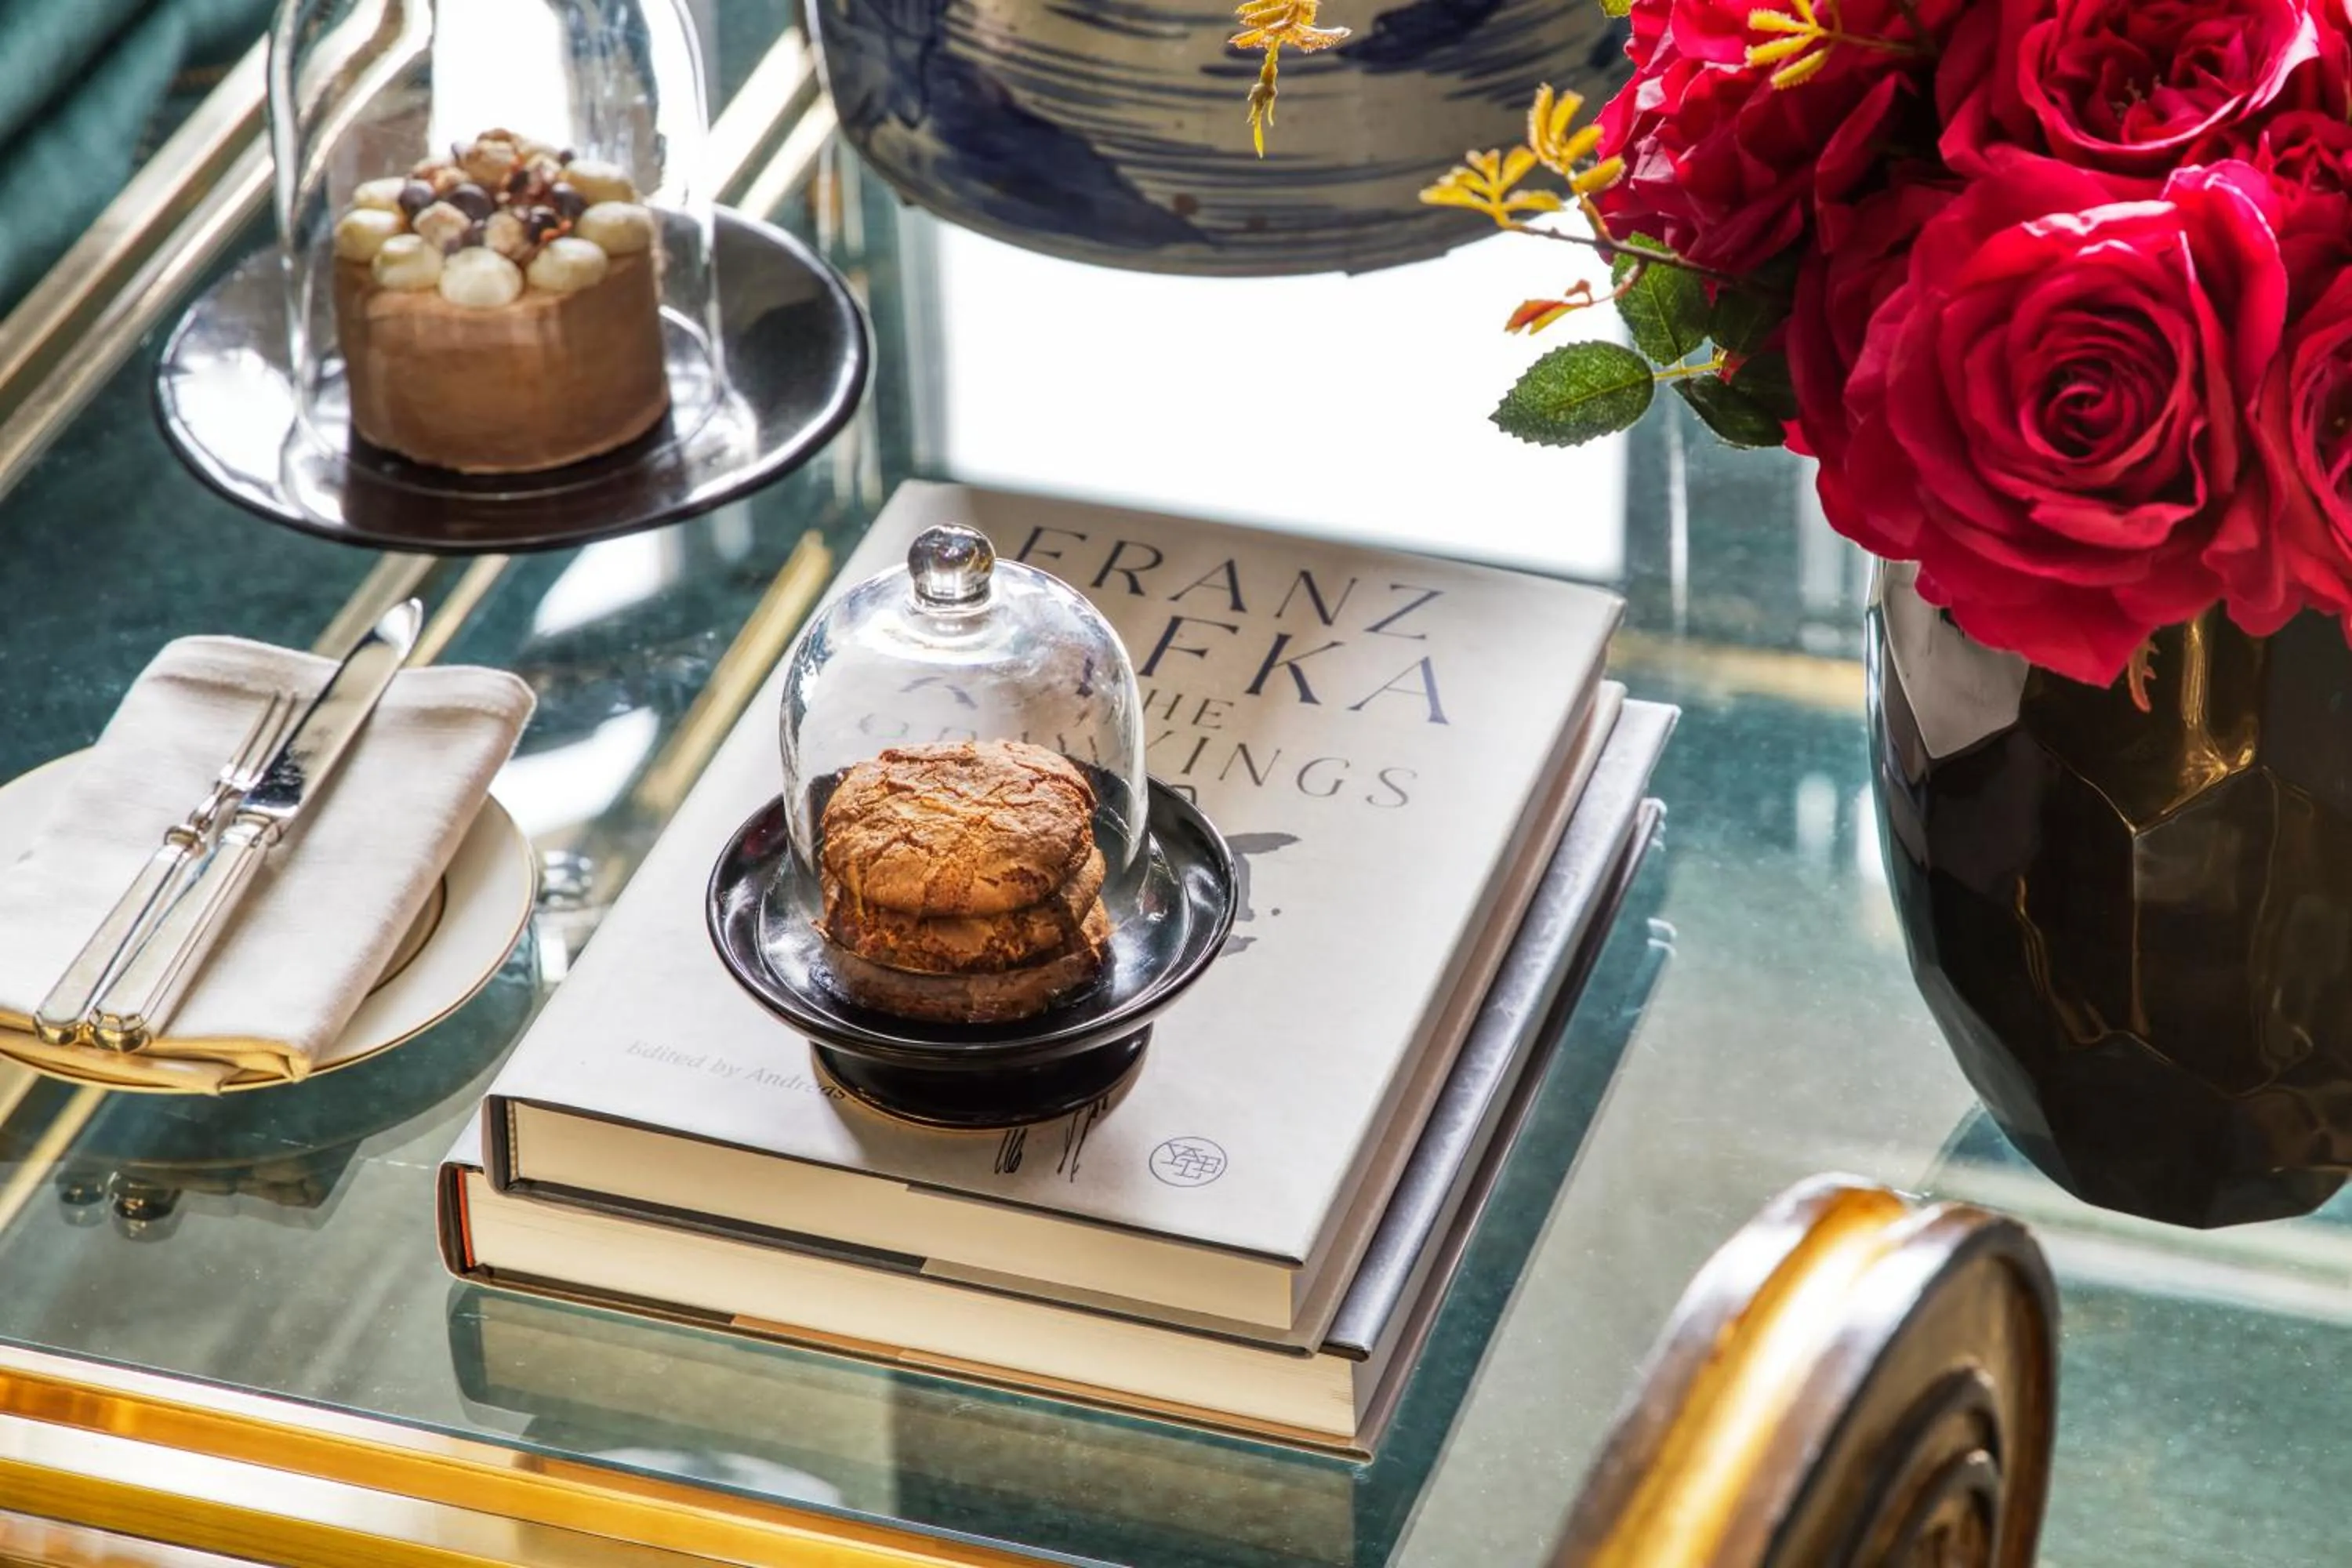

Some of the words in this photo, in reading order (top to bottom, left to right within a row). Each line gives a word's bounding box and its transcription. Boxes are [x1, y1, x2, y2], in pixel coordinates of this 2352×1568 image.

[1016, 526, 1444, 641] FRANZ
[1076, 615, 1450, 725] FKA
[1135, 688, 1235, 730] HE
[627, 1040, 707, 1069] Edited
[711, 1057, 742, 1079] by
